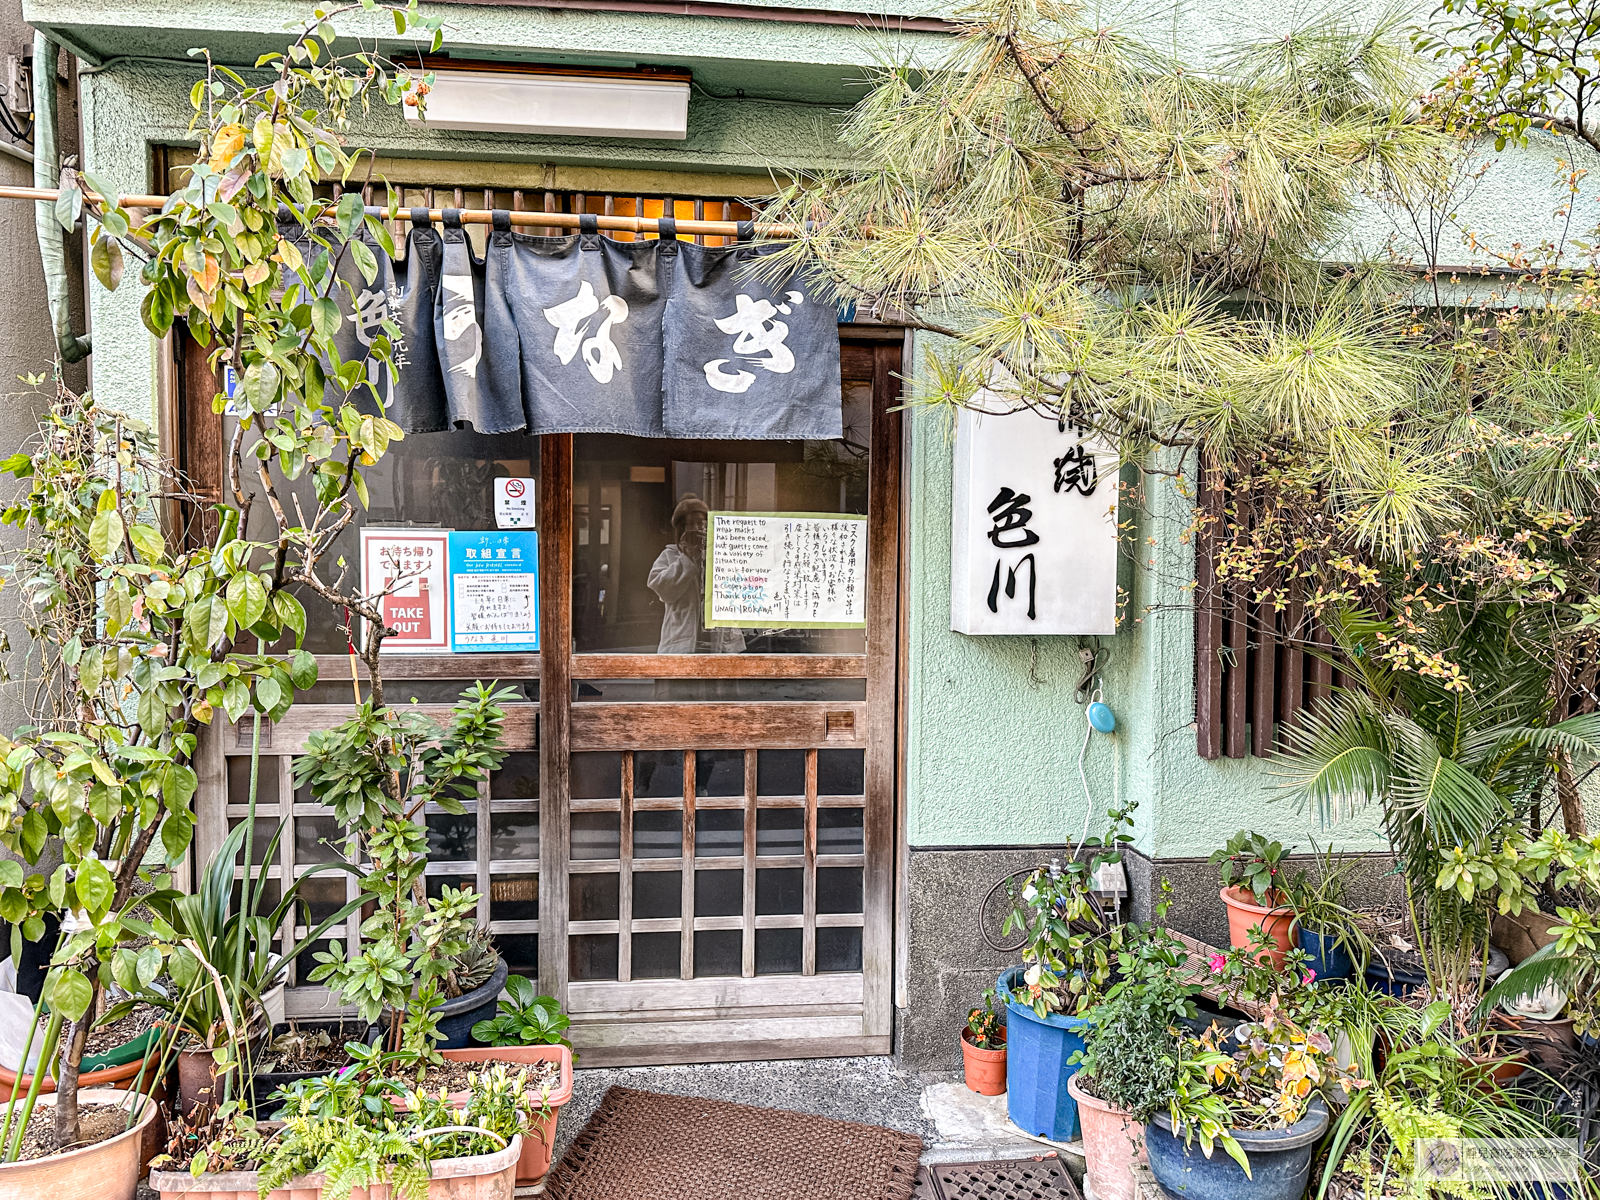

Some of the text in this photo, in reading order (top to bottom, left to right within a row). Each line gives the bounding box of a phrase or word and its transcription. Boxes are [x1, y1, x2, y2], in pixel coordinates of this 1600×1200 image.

[716, 517, 730, 525] The
[733, 519, 757, 528] request
[729, 543, 751, 551] guests
[466, 548, 521, 559] 取組宣言
[730, 550, 754, 558] variety
[987, 486, 1040, 621] 色川
[715, 591, 740, 599] Thank
[390, 608, 424, 618] TAKE
[715, 605, 736, 613] UNAGI
[393, 622, 420, 633] OUT
